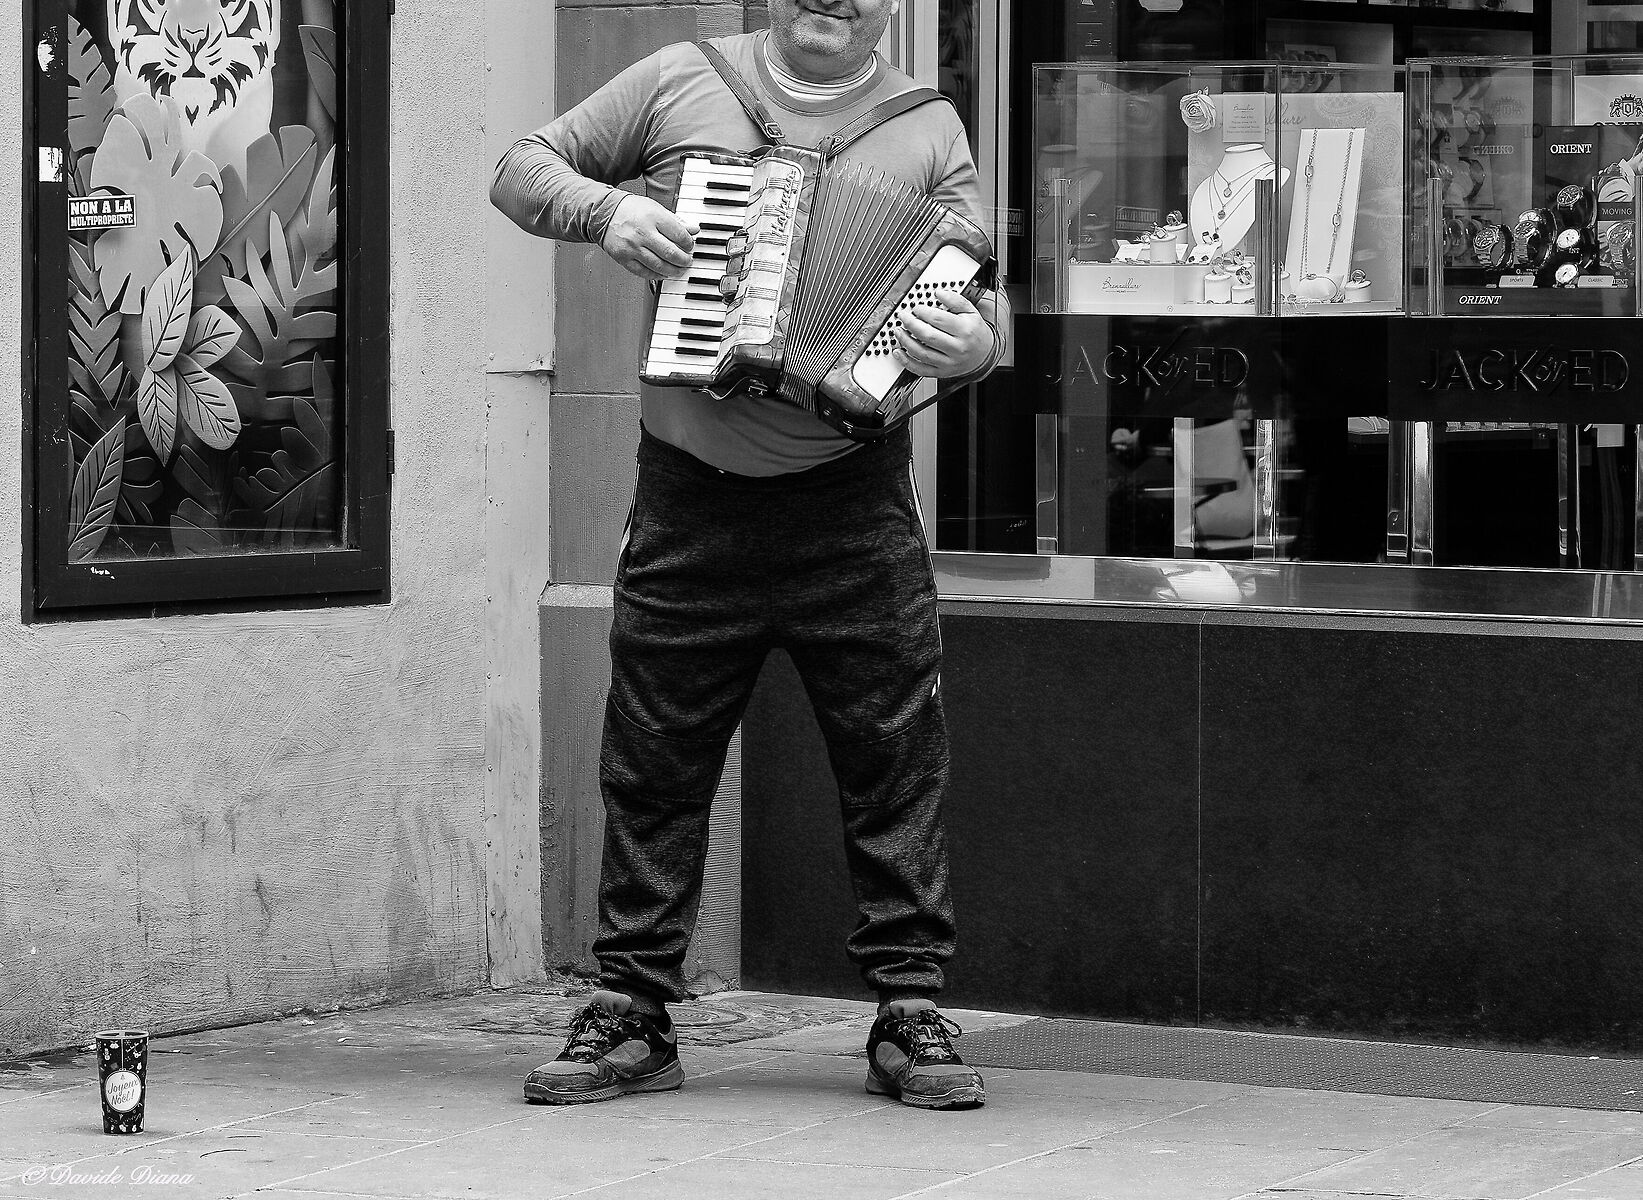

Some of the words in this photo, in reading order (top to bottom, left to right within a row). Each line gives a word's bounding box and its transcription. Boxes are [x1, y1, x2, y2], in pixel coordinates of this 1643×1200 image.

[1550, 143, 1593, 154] ORIENT
[71, 201, 98, 215] NON
[102, 200, 111, 213] A
[114, 199, 132, 212] LA
[1458, 295, 1503, 305] ORIENT
[1045, 345, 1160, 387] JACK
[1192, 346, 1249, 388] ED
[1419, 349, 1538, 392] JACK
[1569, 349, 1630, 392] ED
[107, 1079, 139, 1097] Joyeux
